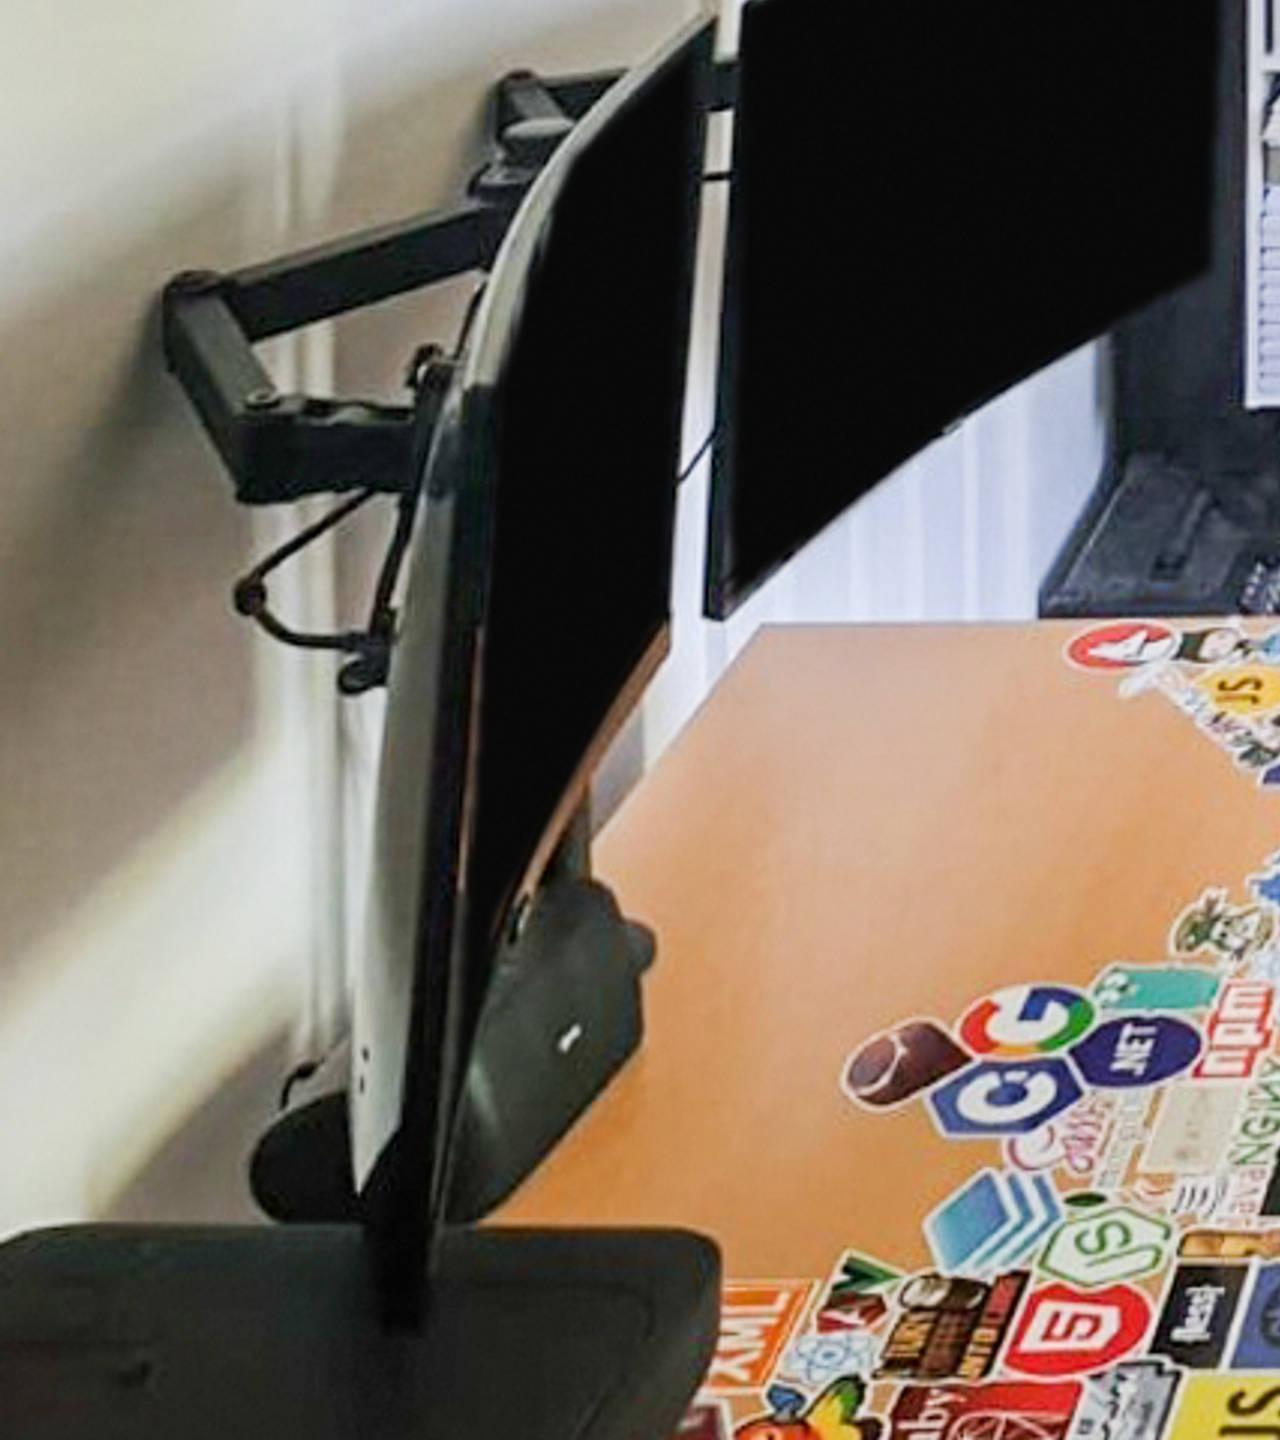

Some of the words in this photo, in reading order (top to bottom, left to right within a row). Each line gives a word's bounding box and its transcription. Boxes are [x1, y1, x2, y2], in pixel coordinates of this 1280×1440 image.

[1217, 677, 1263, 707] JS
[1109, 1022, 1156, 1076] .NET
[1206, 982, 1269, 1074] npm
[709, 1290, 792, 1385] XML
[1040, 1308, 1109, 1347] 5
[897, 1387, 967, 1440] by
